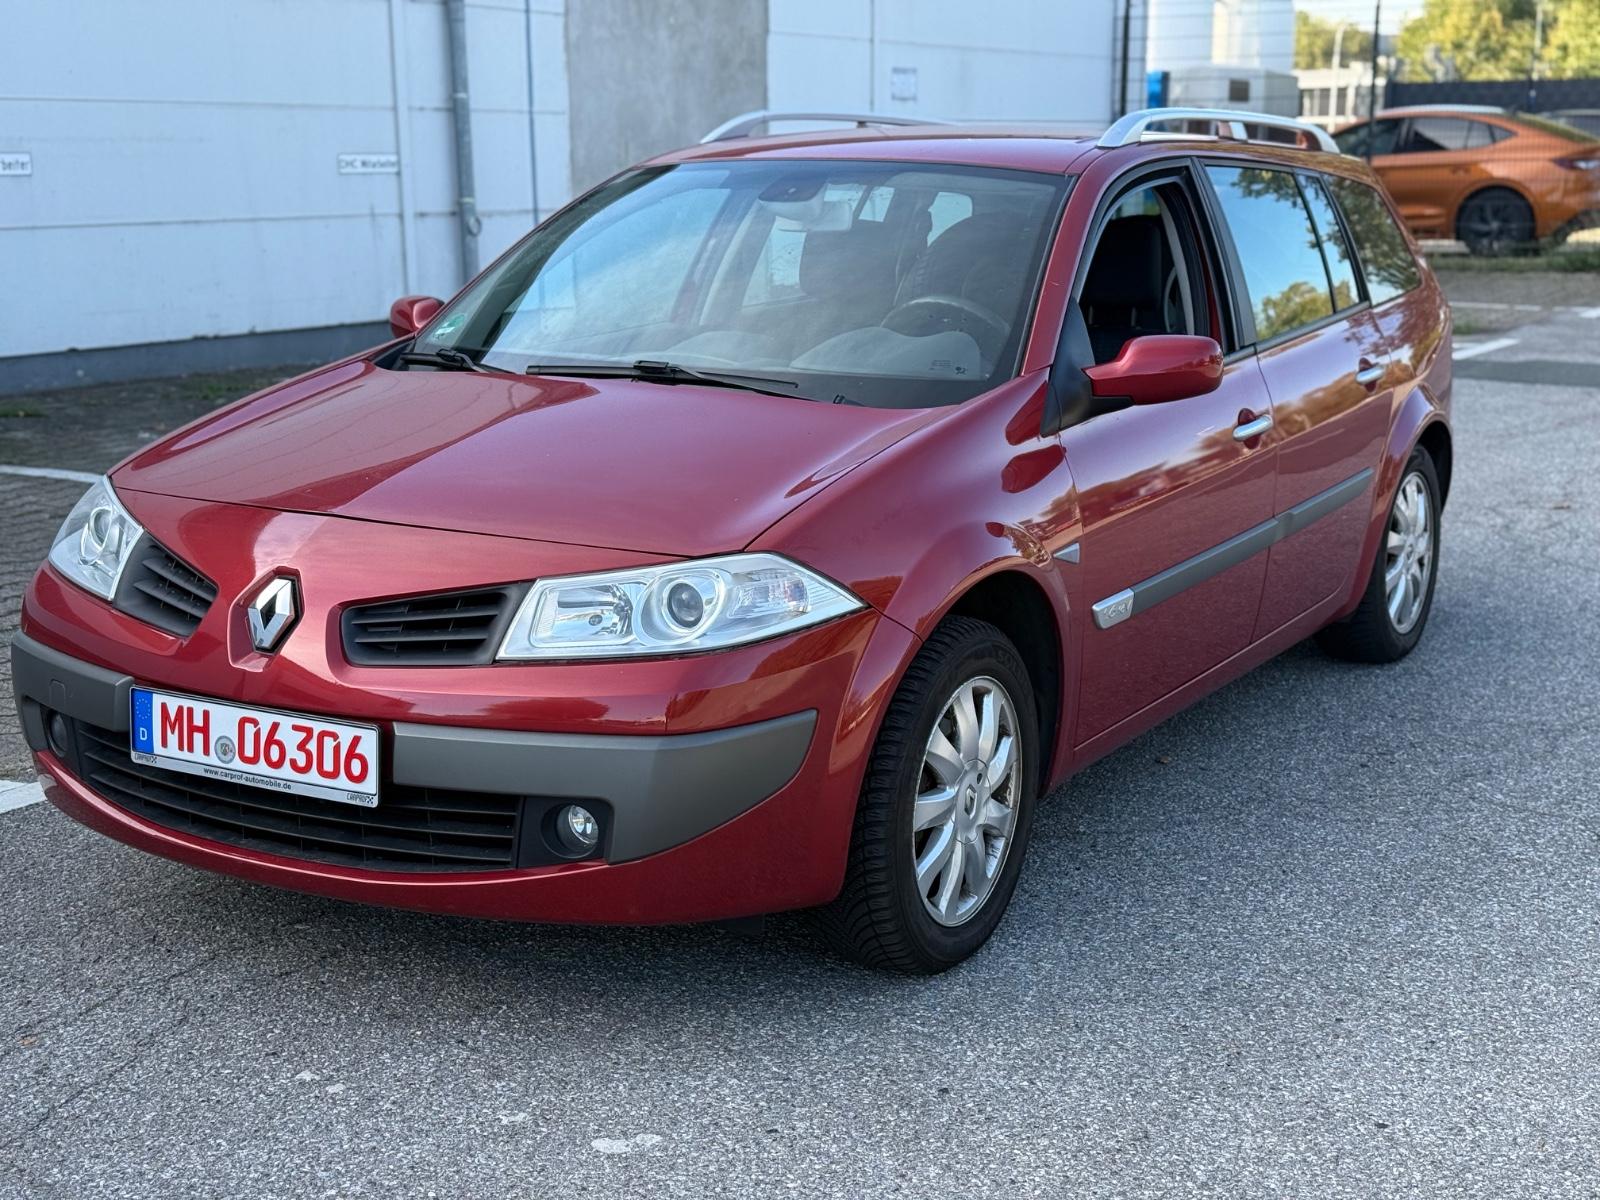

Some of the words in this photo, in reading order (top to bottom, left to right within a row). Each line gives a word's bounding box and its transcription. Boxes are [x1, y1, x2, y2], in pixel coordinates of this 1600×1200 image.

[140, 727, 148, 741] D
[160, 701, 211, 757] MH
[237, 715, 369, 784] 06306
[203, 767, 292, 791] www.carprof-automobile.de
